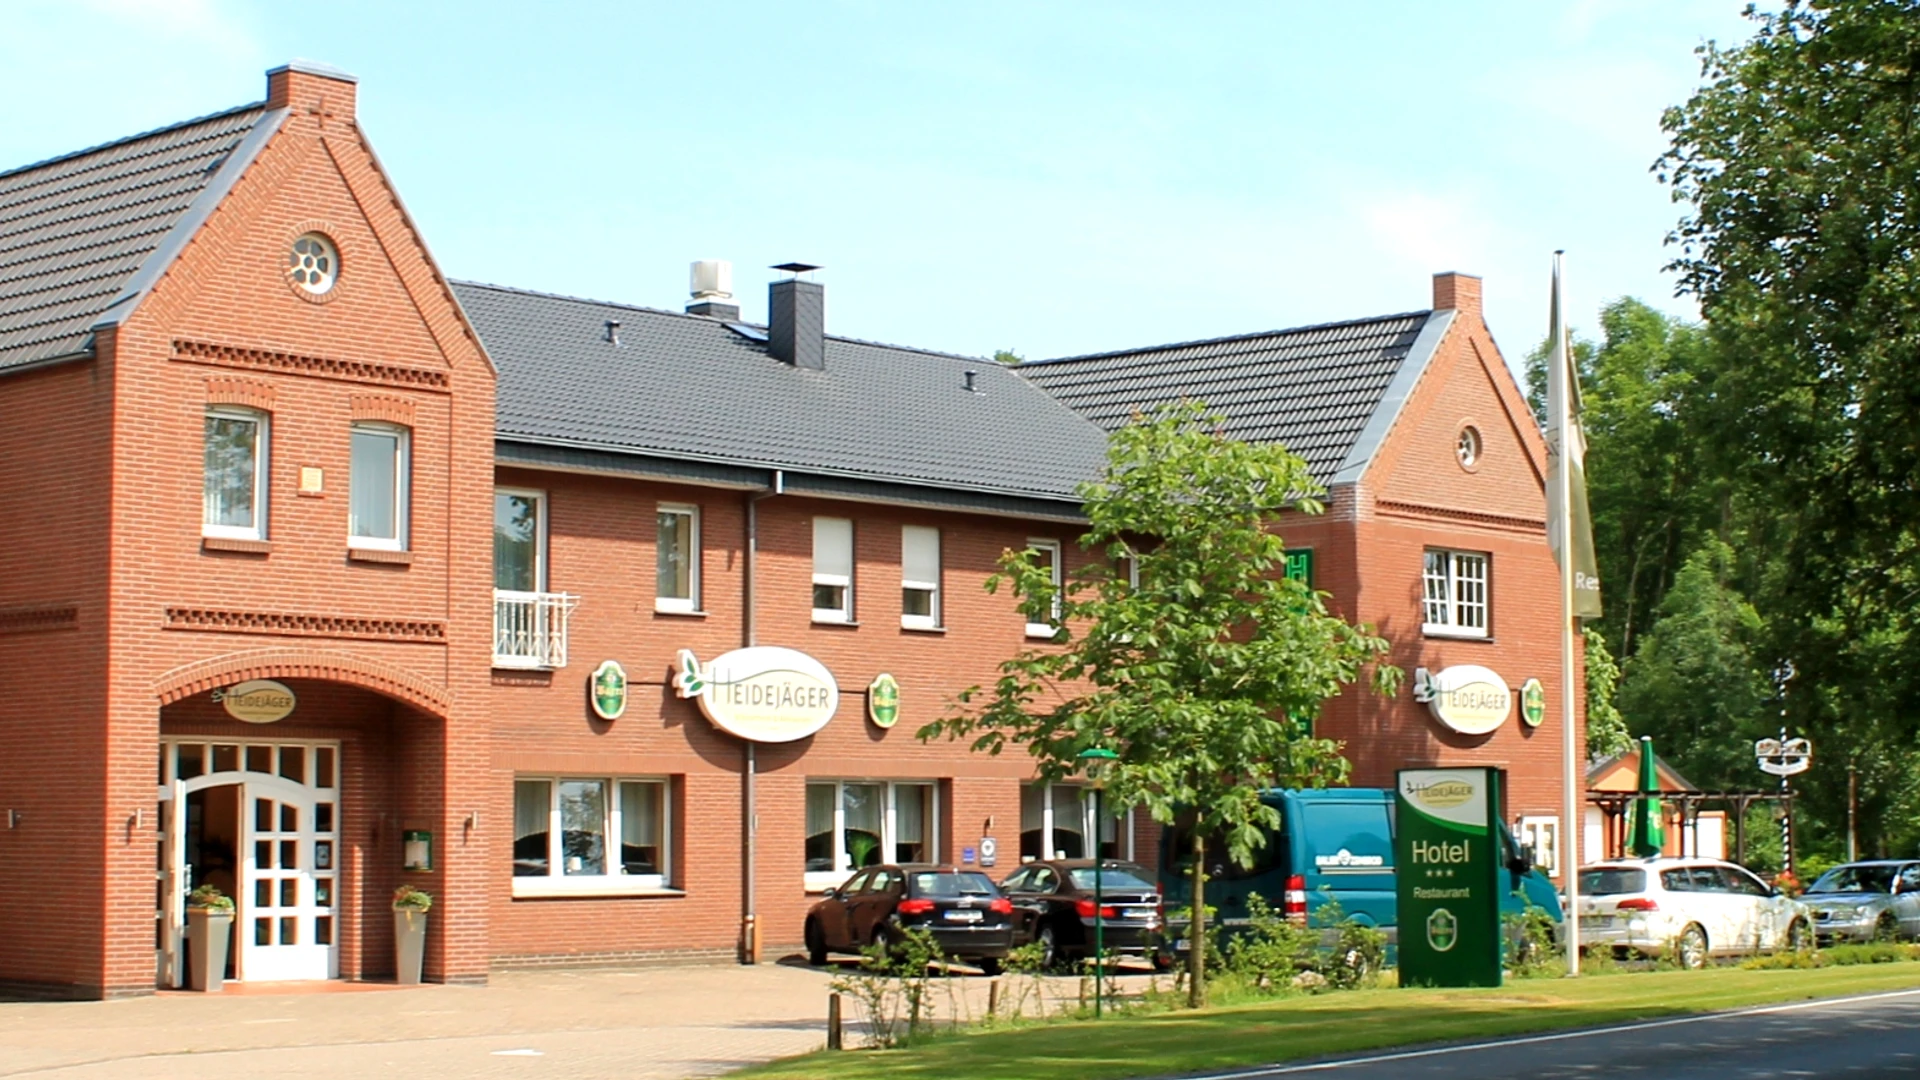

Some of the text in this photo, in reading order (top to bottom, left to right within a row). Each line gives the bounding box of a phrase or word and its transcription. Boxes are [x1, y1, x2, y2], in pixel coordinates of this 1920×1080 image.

[711, 667, 829, 709] HEIDEJÄGER
[1412, 839, 1469, 863] Hotel
[1413, 887, 1470, 899] Restaurant
